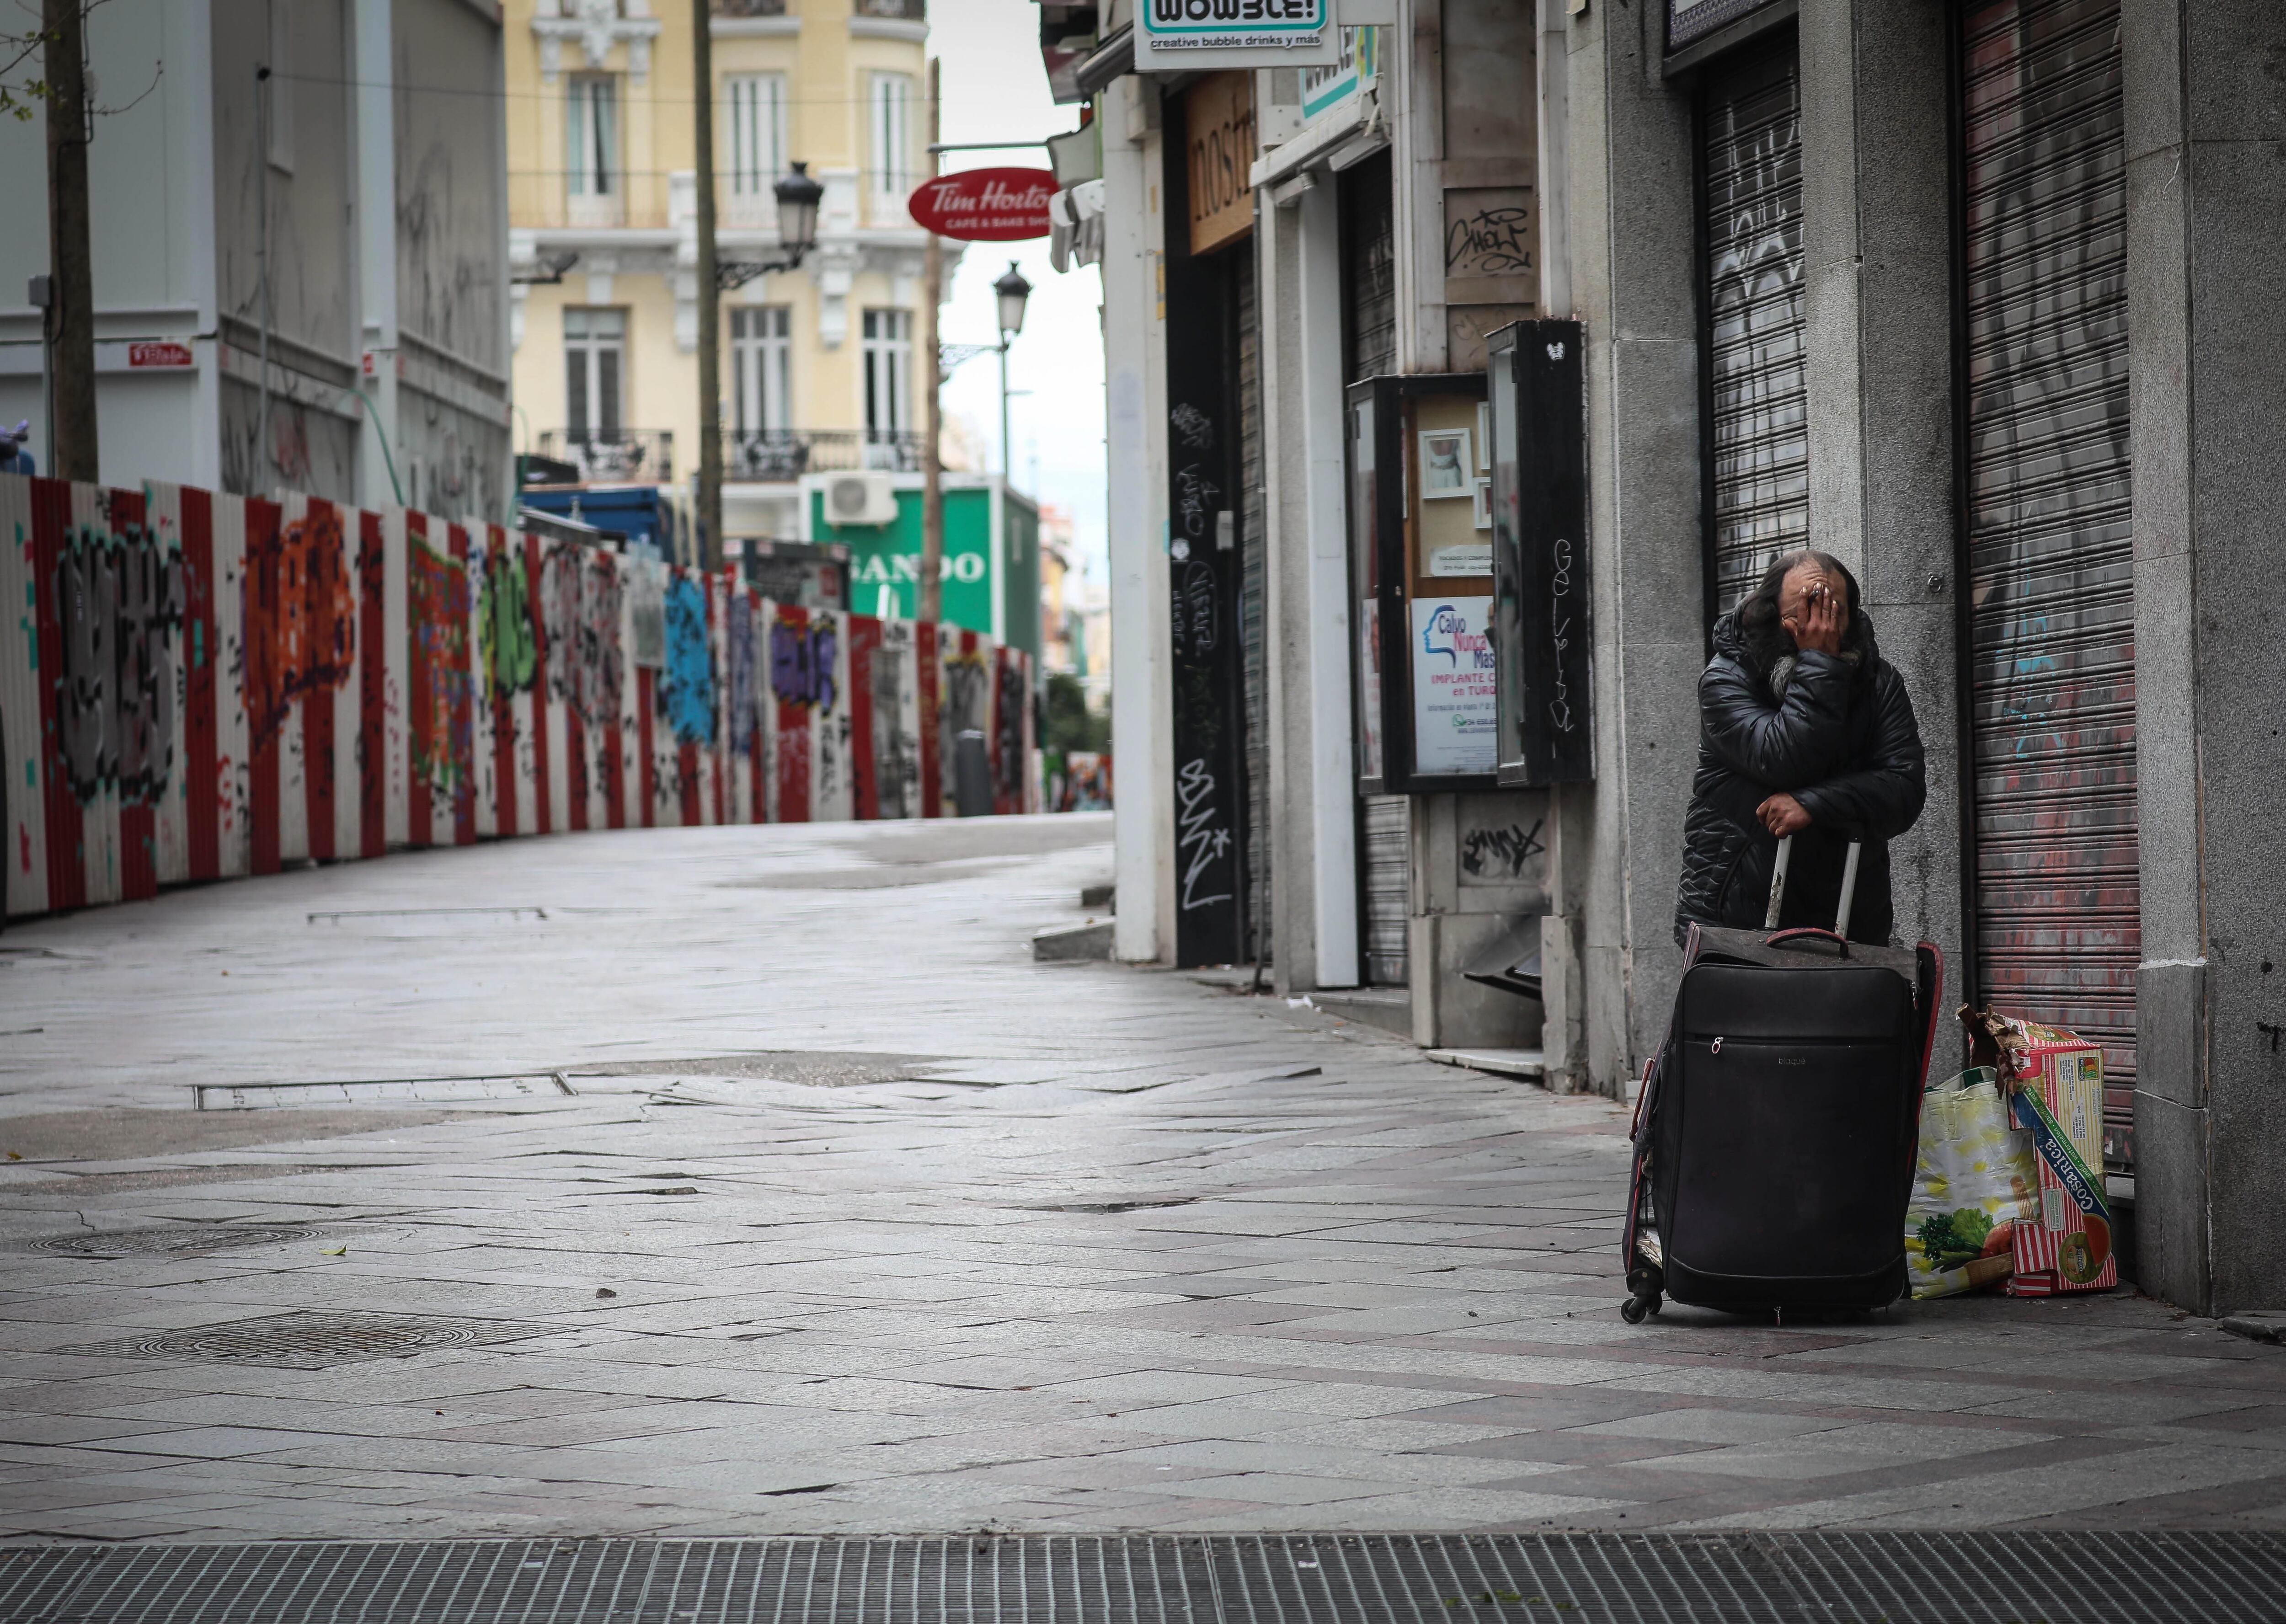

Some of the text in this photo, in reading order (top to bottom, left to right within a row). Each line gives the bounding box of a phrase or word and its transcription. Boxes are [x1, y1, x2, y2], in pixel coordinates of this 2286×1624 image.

[1151, 34, 1320, 48] creative bubble drinks y más
[930, 182, 976, 213] Tim
[1439, 614, 1466, 634] Calvo
[1454, 631, 1487, 652] Nunca
[1431, 673, 1485, 684] IMPLANTE
[2056, 1127, 2078, 1163] watermelon
